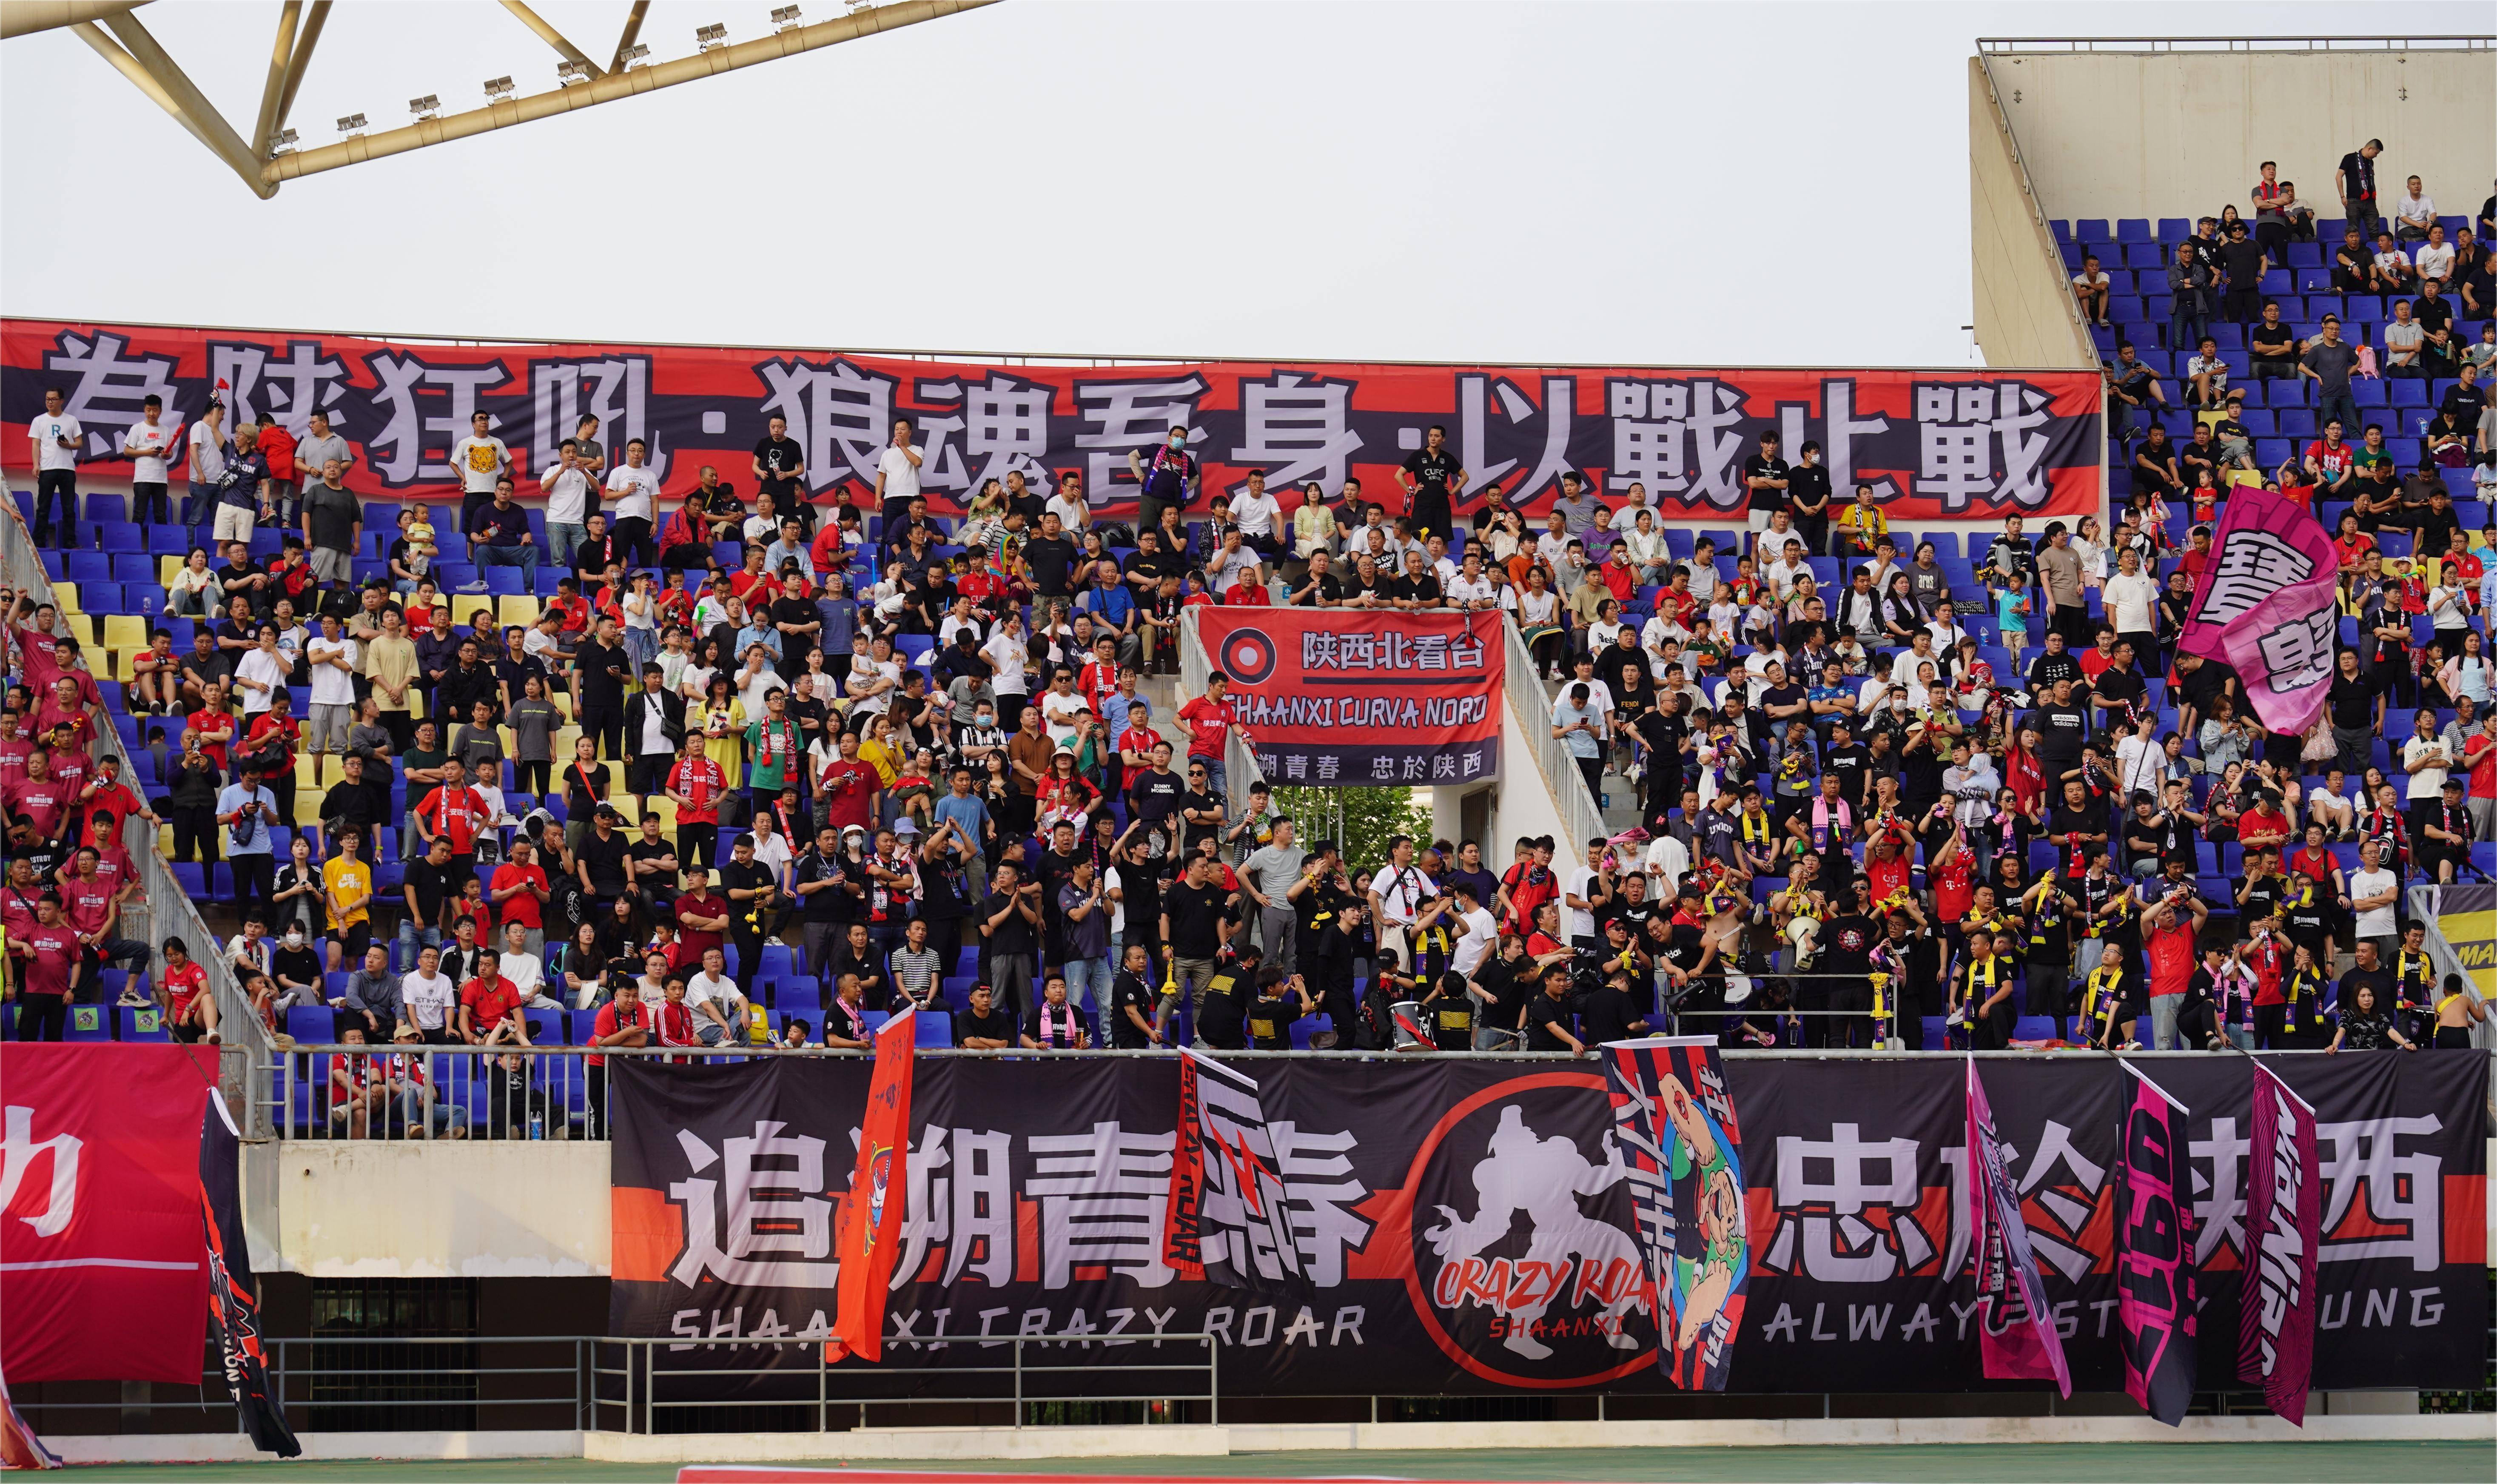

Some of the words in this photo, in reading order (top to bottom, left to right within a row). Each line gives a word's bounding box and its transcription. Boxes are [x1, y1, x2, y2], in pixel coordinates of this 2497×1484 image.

[1424, 468, 1444, 477] CUFC
[971, 595, 988, 603] CUF
[1598, 632, 1618, 644] Rela
[1302, 632, 1485, 669] 陕西北看台
[1232, 693, 1334, 727] SHAANXI
[1338, 696, 1420, 728] CURVA
[1425, 693, 1489, 728] NORD
[1257, 754, 1340, 779] 朔青春
[1370, 749, 1483, 780] 忠於陕西
[1708, 821, 1734, 835] UNION
[30, 855, 51, 863] ESTROY
[342, 874, 356, 882] JUST
[1883, 874, 1899, 886] CUF
[1664, 948, 1682, 959] idas
[2459, 942, 2497, 966] MA
[1611, 1063, 1677, 1353] 大力出奇
[1438, 1257, 1569, 1316] CRAZY
[1578, 1256, 1653, 1316] ROA
[669, 1306, 952, 1353] SHAAXI
[978, 1306, 1177, 1350] CRAZY
[1199, 1305, 1366, 1349] ROAR
[1489, 1315, 1625, 1339] SHAANXI
[1762, 1301, 1979, 1344] ALWAY
